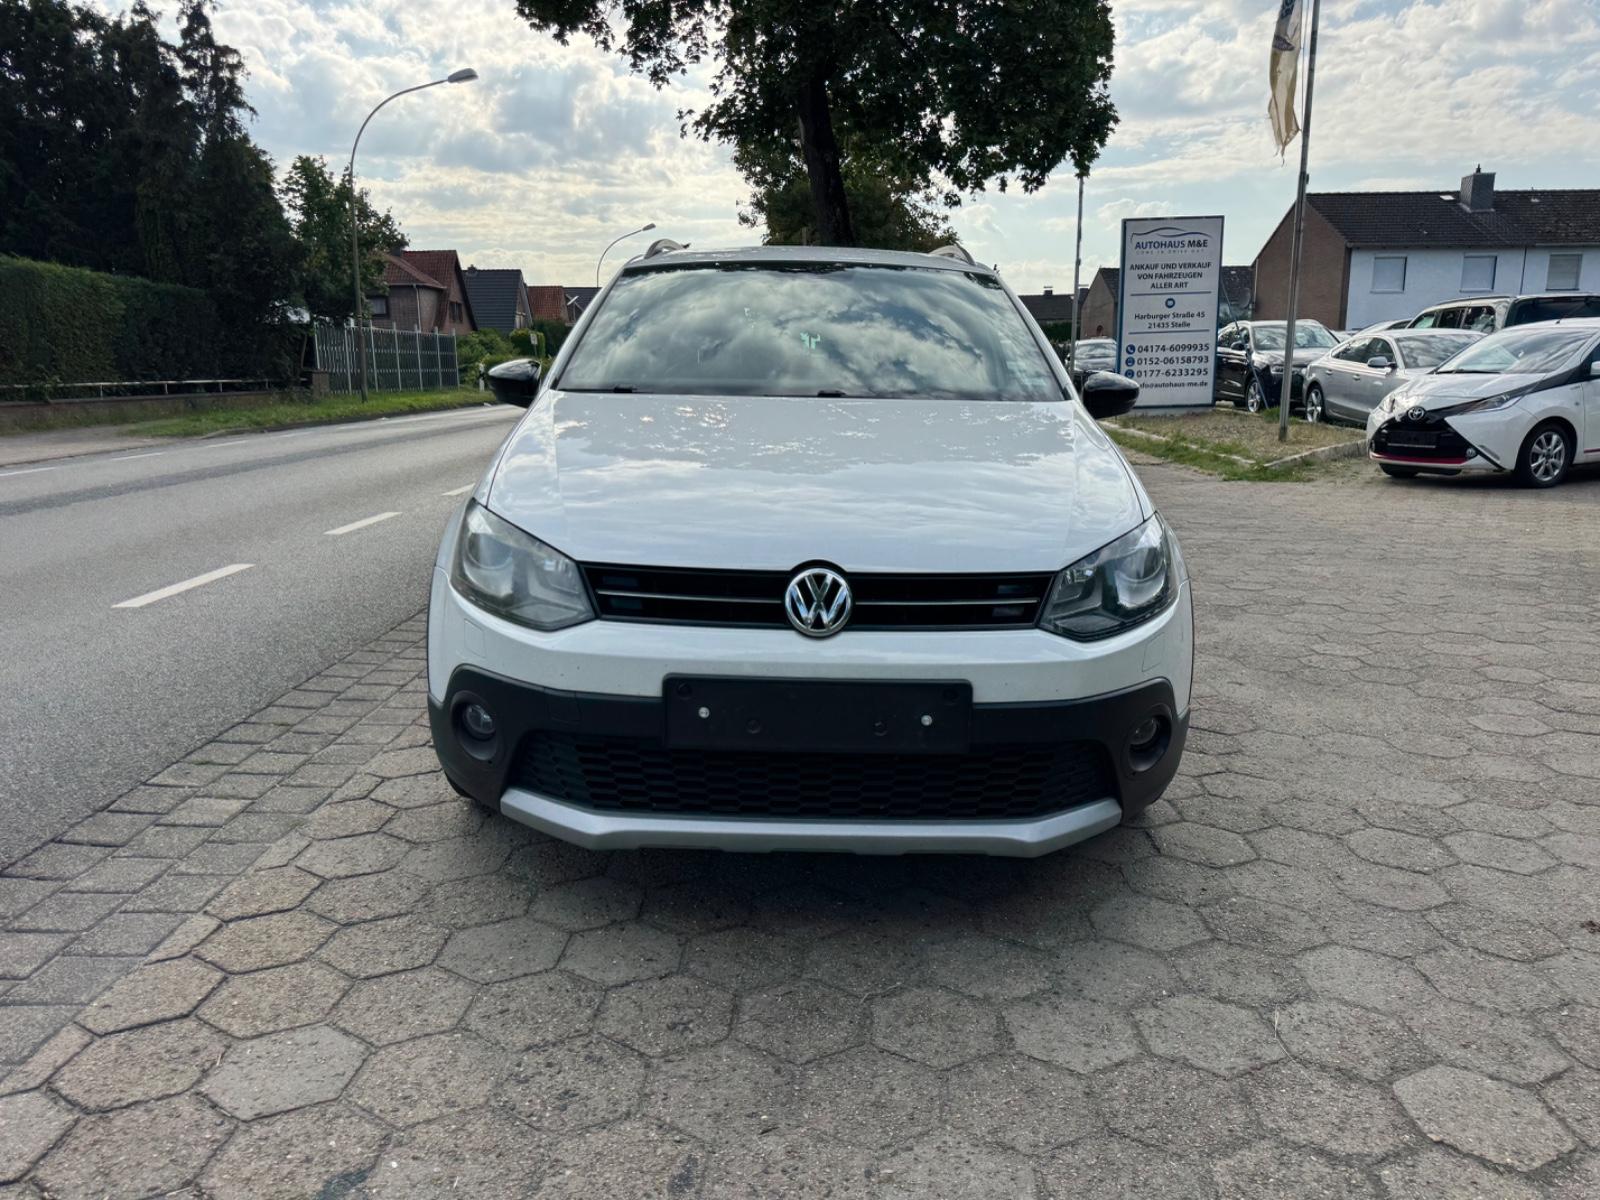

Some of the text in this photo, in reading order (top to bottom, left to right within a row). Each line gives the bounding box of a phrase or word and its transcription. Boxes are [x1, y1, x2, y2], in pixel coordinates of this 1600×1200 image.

[1135, 239, 1208, 250] AUTOHAUS M&E
[1130, 263, 1159, 271] ANKAUF
[1155, 271, 1203, 279] FAHRZEUGEN
[1135, 313, 1170, 321] Harburger
[1172, 311, 1195, 319] Straße
[1137, 343, 1210, 353] 04174-6099935
[1137, 355, 1209, 365] 0152-06158793
[1136, 368, 1208, 378] 0177-6233295
